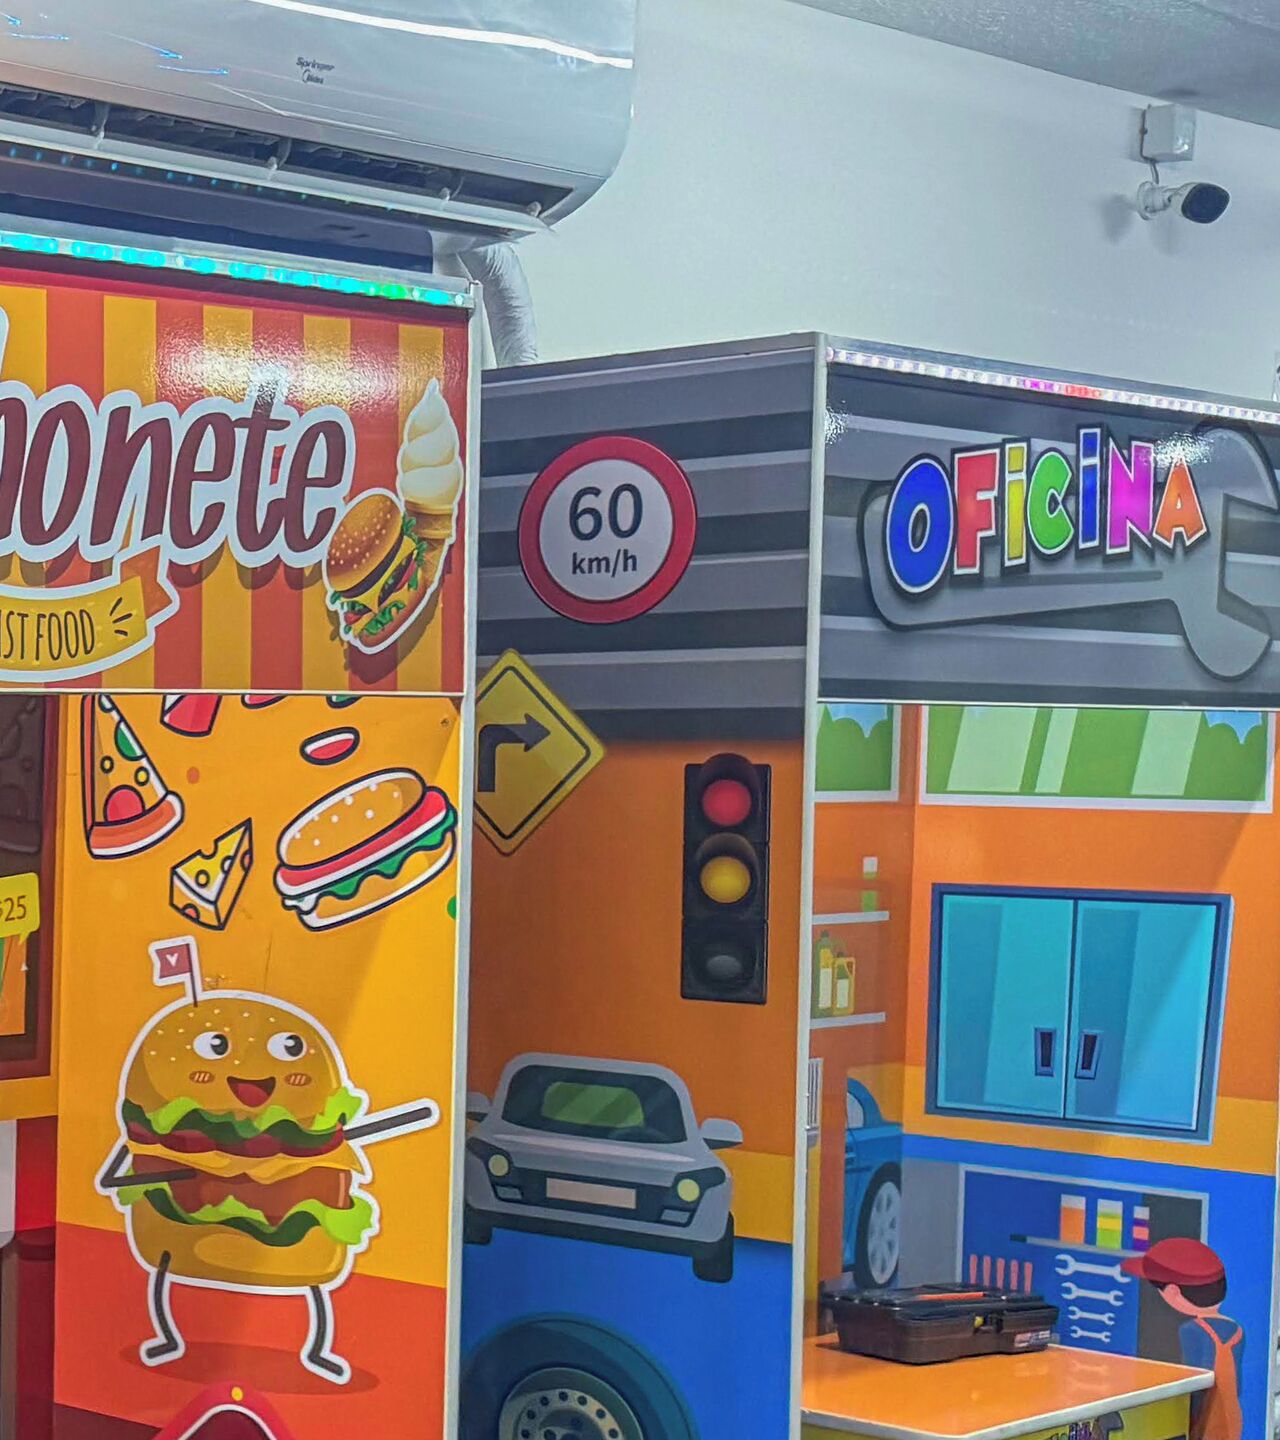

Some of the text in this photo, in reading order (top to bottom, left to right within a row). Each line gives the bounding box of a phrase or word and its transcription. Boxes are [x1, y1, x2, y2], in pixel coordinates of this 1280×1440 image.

[568, 481, 643, 543] 60
[571, 547, 639, 577] km/h
[35, 606, 96, 661] FOOD
